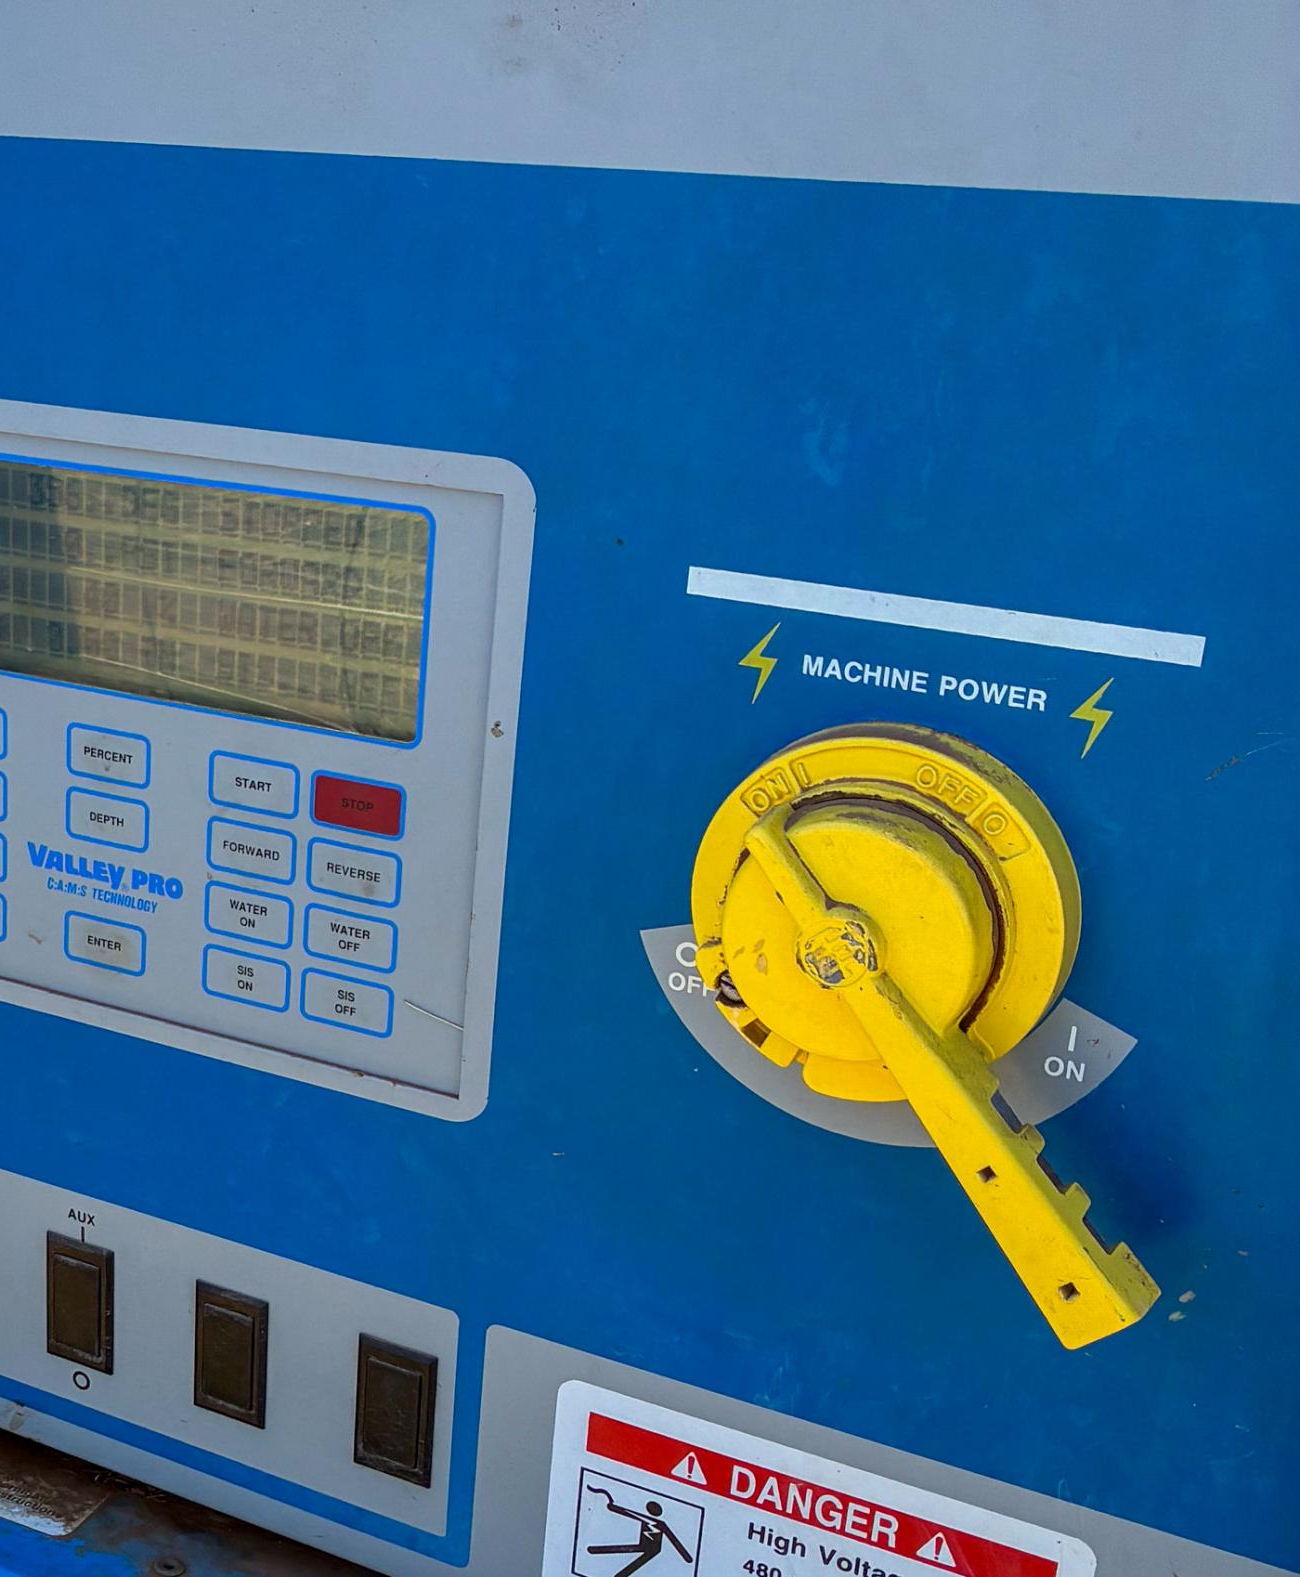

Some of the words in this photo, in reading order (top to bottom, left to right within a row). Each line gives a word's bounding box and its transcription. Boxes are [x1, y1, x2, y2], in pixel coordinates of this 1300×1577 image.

[802, 654, 928, 694] MACHINE
[939, 676, 1048, 712] POWER
[83, 746, 133, 765] PERCENT
[234, 777, 272, 793] START
[750, 773, 791, 813] ON
[915, 763, 980, 806] OFF
[341, 797, 375, 812] STOP
[89, 812, 125, 828] DEPTH
[222, 841, 280, 862] FORWARD
[27, 841, 125, 891] VALLEY
[131, 869, 184, 900] PRO
[326, 862, 381, 883] REVERSE
[92, 888, 158, 914] TECHNOLOGY
[229, 899, 268, 917] WATER
[239, 917, 256, 929] ON
[330, 922, 371, 941] WATER
[87, 935, 122, 952] ENTER
[338, 938, 361, 952] OFF
[237, 965, 254, 978] SIS
[237, 979, 254, 992] ON
[337, 990, 356, 1003] SIS
[334, 1003, 357, 1017] OFF
[1044, 1056, 1085, 1082] ON
[68, 1208, 95, 1226] AUX
[730, 1464, 900, 1549] DANGER
[747, 1522, 806, 1558] High
[819, 1545, 904, 1577] Volta
